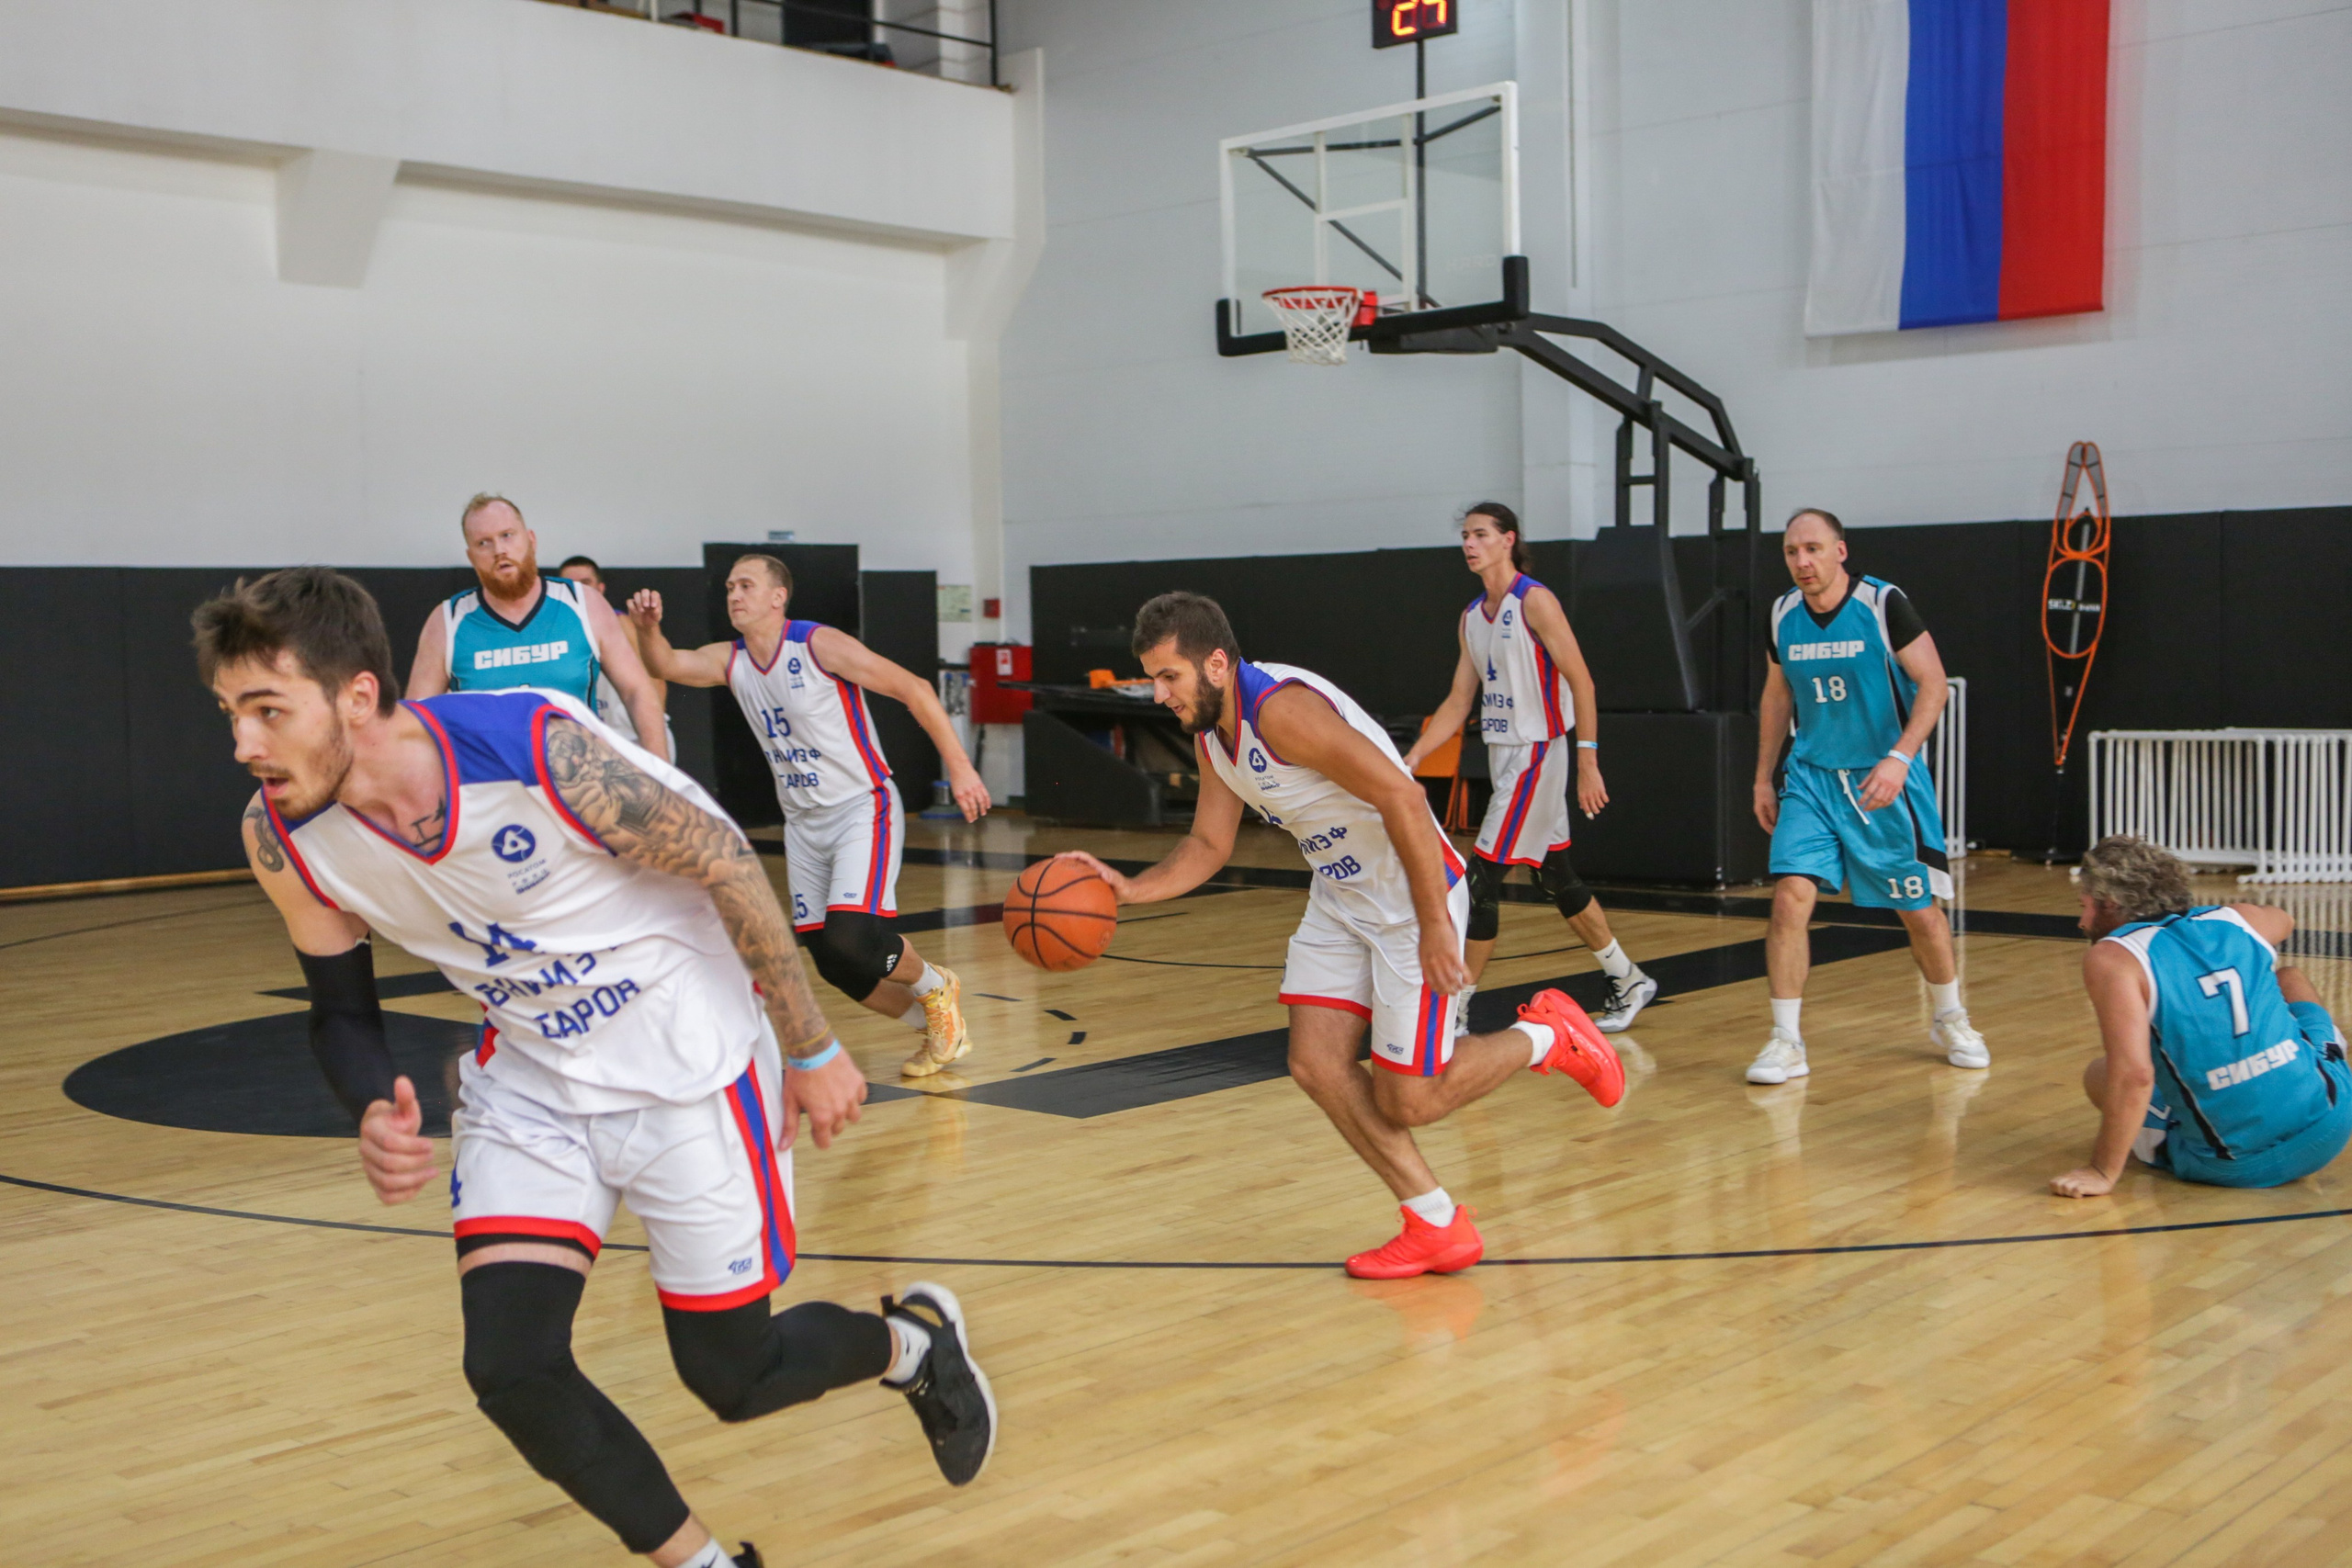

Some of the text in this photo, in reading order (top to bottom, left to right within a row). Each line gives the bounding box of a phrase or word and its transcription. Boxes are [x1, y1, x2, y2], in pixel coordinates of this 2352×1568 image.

[474, 640, 569, 670] СИБУР
[1788, 640, 1864, 660] СИБУР
[1812, 675, 1847, 704] 18
[761, 707, 791, 739] 15
[1481, 717, 1508, 733] РОВ
[1319, 855, 1362, 880] РОВ
[1887, 875, 1924, 899] 18
[793, 894, 808, 919] 5
[474, 950, 597, 1007] ВНИИЭ
[2195, 966, 2250, 1040] 7
[2206, 1039, 2300, 1090] СИБУР
